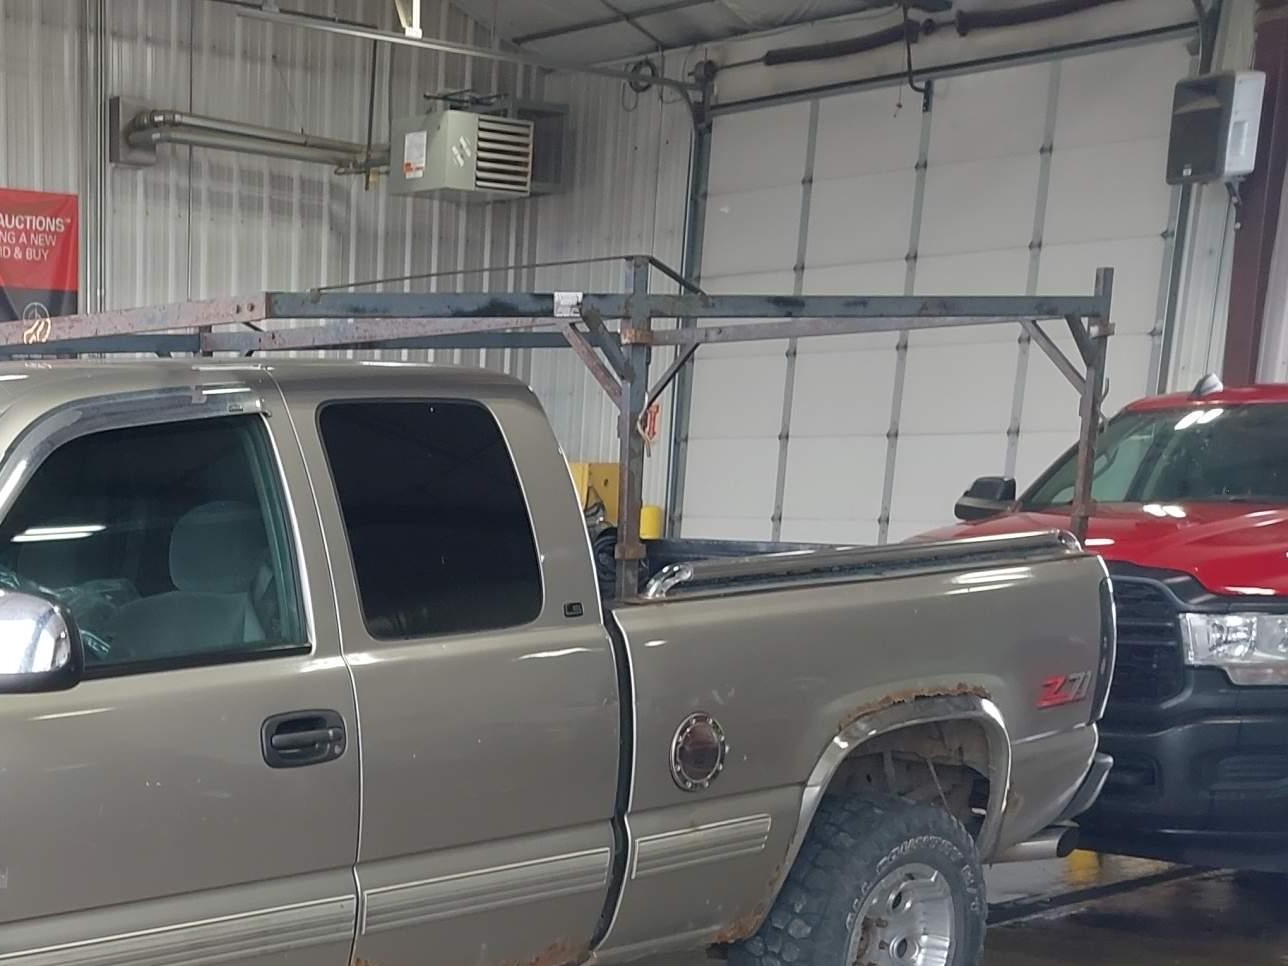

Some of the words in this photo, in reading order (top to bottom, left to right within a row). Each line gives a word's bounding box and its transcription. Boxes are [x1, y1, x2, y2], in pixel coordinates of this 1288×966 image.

[18, 231, 27, 244] A
[31, 232, 56, 246] NEW
[13, 246, 22, 259] &
[26, 248, 49, 261] BUY
[1036, 670, 1092, 710] Z71
